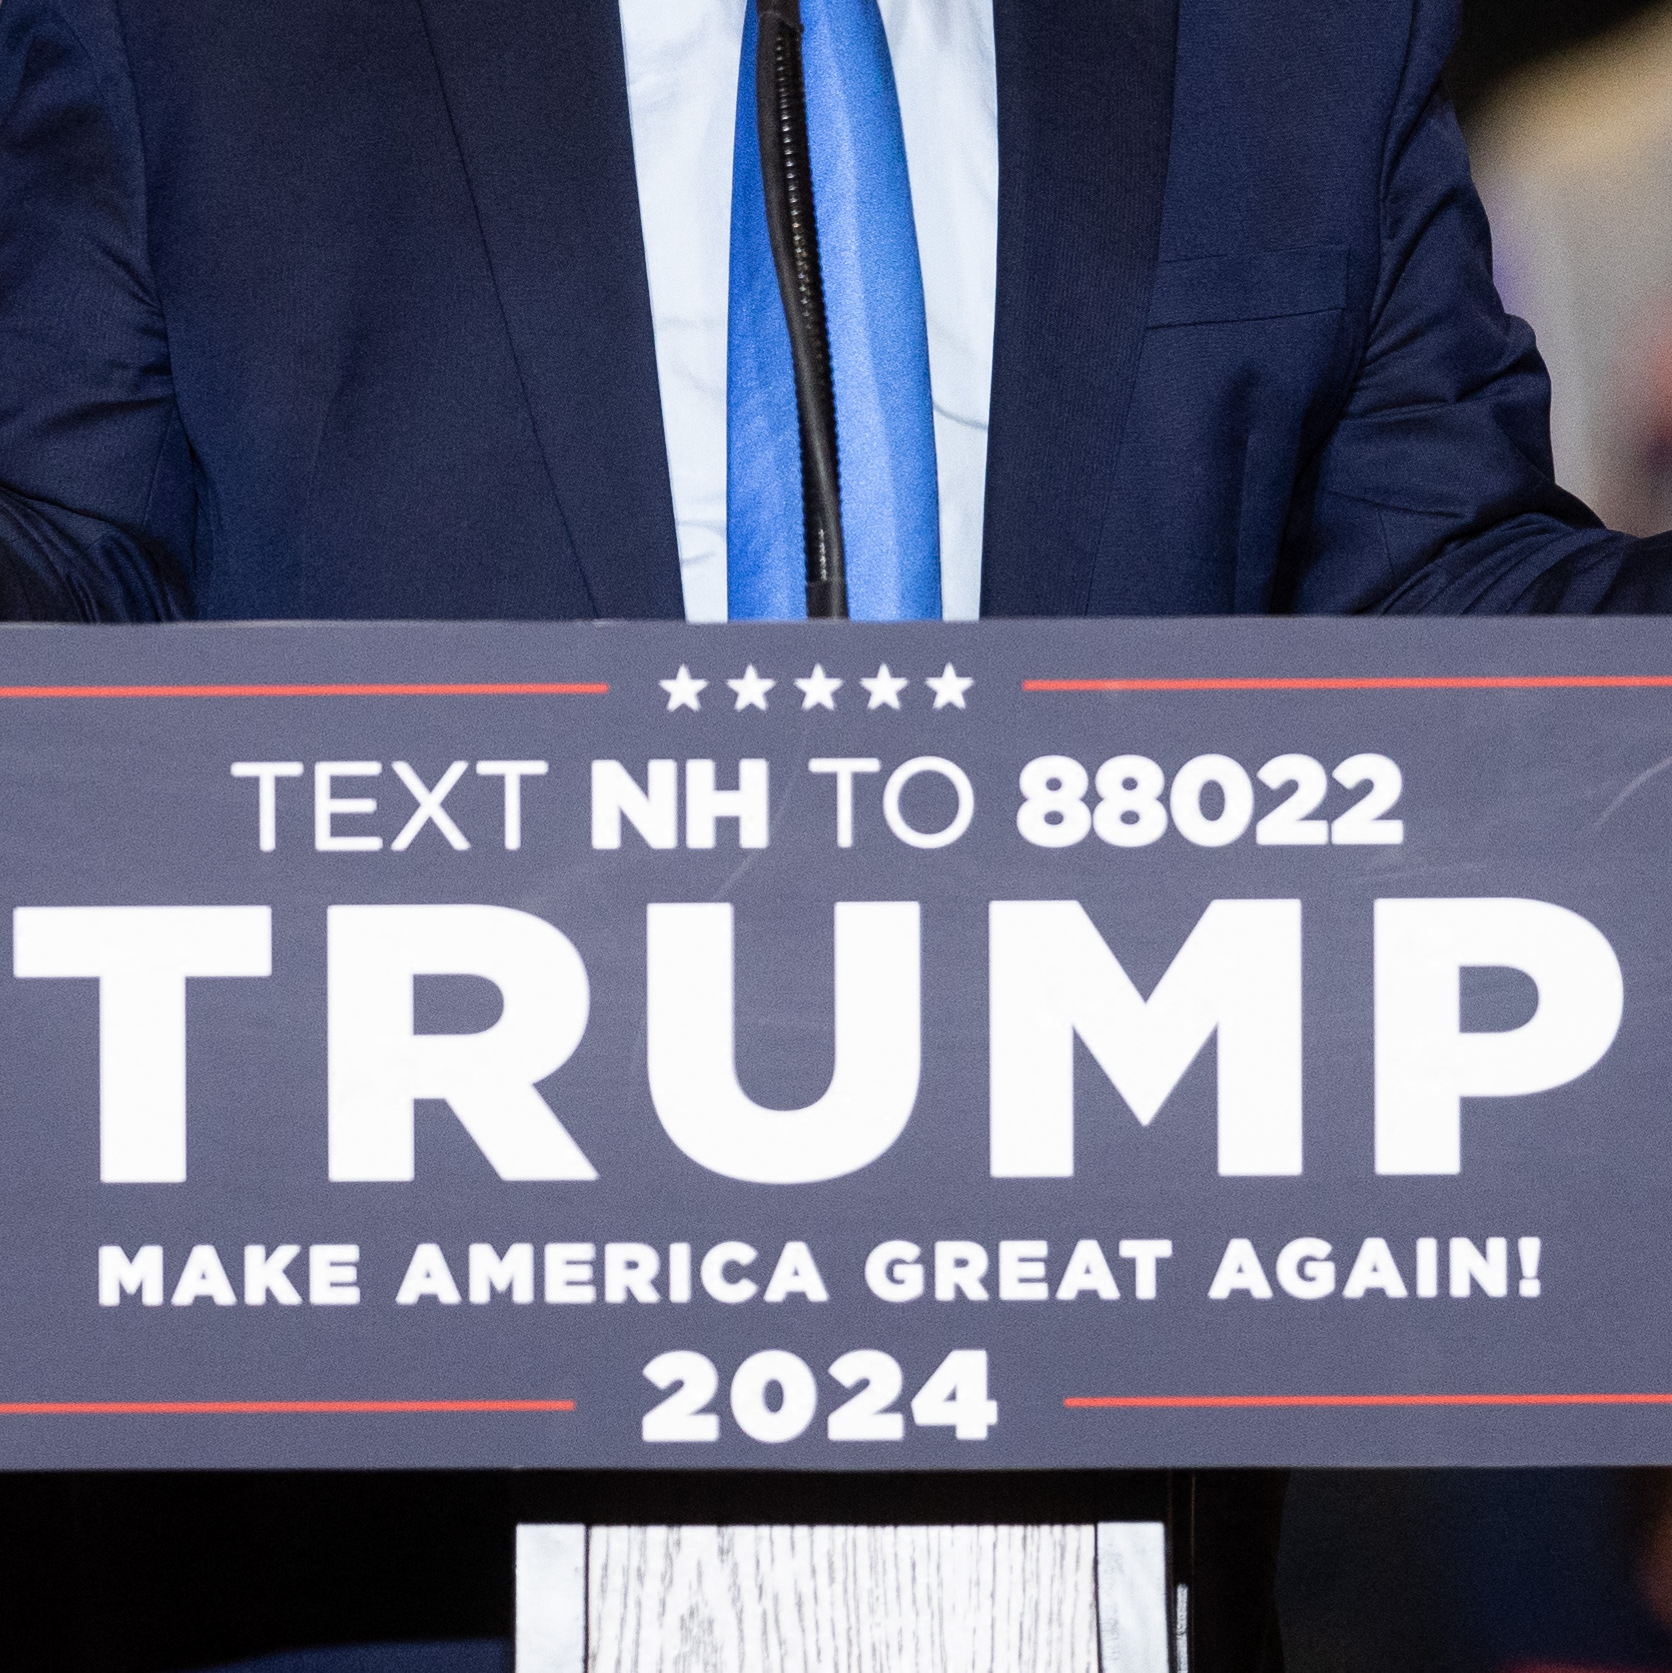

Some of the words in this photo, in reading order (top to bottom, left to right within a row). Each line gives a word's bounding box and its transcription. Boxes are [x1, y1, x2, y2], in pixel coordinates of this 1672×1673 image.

[230, 759, 549, 853] TEXT
[590, 758, 770, 851] NH
[808, 755, 976, 850] TO
[1016, 752, 1405, 849] 88022
[12, 896, 1625, 1185] TRUMP
[98, 1243, 361, 1307] MAKE
[395, 1240, 830, 1305] AMERICA
[864, 1238, 1173, 1303] GREAT
[1208, 1236, 1542, 1300] AGAIN!
[641, 1348, 999, 1444] 2024
